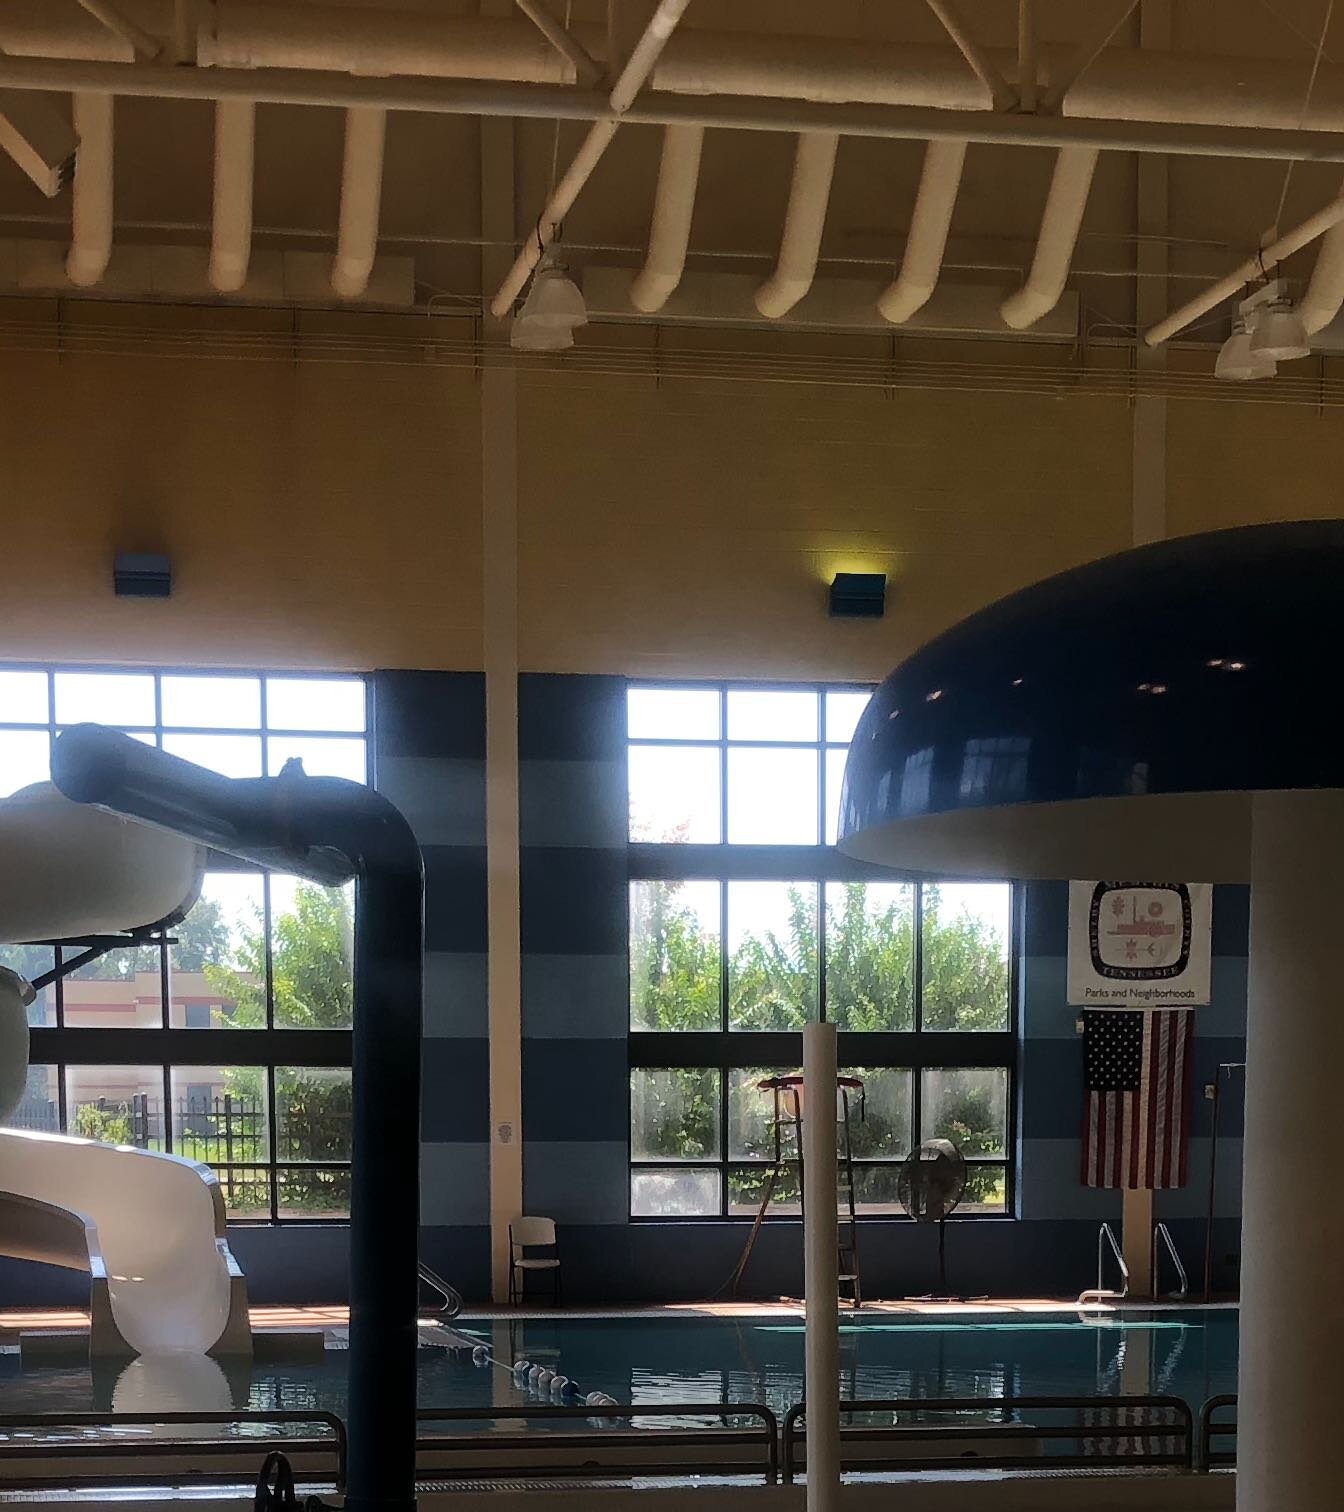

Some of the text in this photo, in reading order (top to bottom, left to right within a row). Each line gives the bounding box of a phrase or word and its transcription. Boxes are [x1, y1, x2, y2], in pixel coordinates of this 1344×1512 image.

[1103, 966, 1180, 977] TENNESSEE
[1085, 987, 1195, 1000] Parks and Neighborhoods
